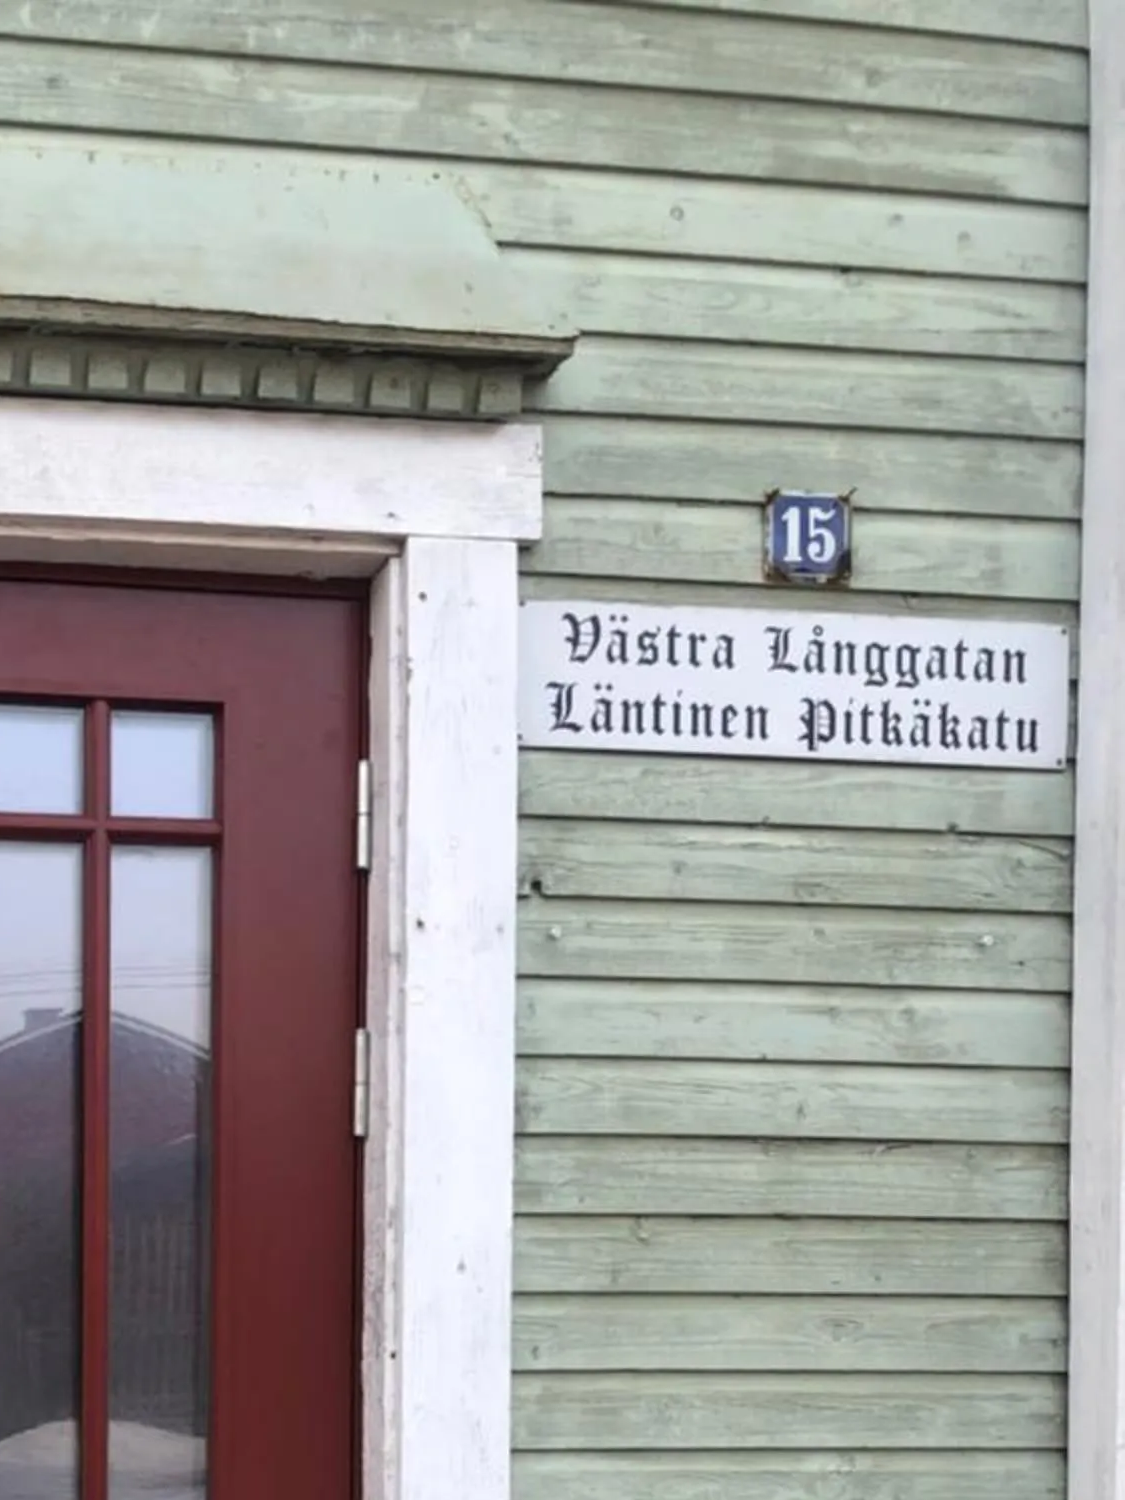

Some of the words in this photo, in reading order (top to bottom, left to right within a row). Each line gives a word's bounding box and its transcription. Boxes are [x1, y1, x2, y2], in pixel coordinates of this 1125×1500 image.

[780, 506, 836, 563] 15
[561, 612, 736, 670] Västra
[764, 624, 1028, 689] Långgatan
[544, 681, 770, 741] Läntinen
[796, 697, 1040, 753] Pitkäkatu
